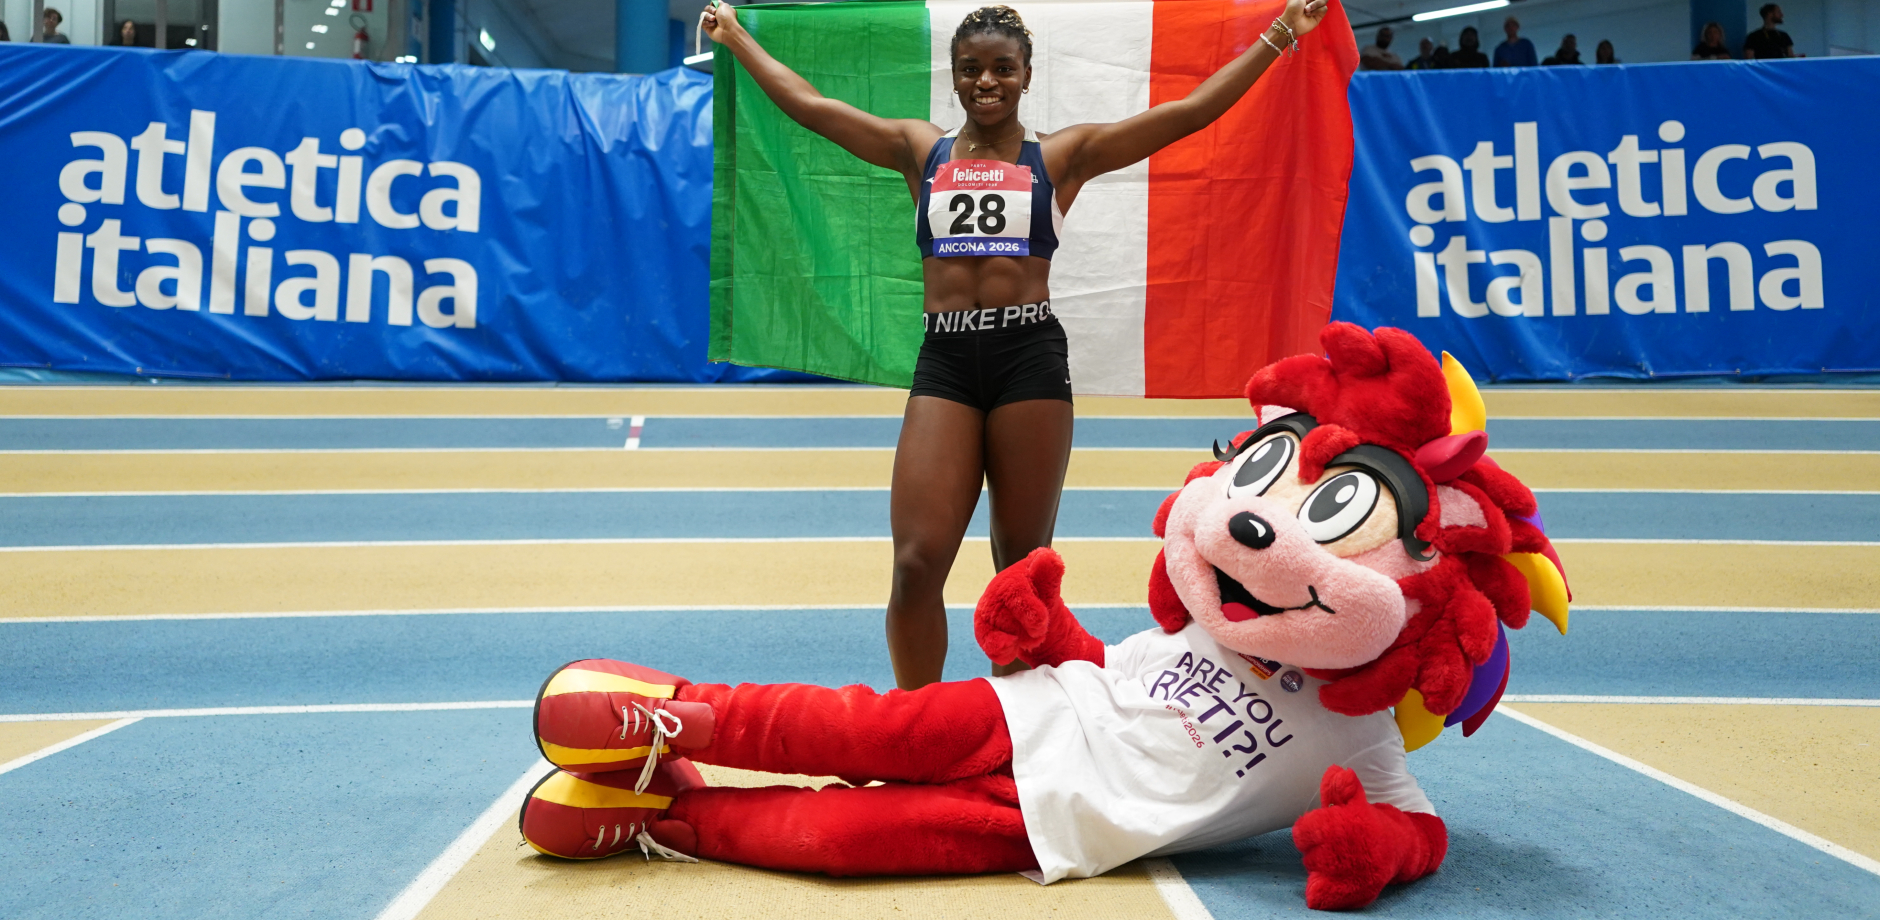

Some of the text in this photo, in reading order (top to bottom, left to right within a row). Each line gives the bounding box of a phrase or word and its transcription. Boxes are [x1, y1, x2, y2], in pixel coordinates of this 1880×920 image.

[59, 109, 482, 233] atletica
[948, 193, 1006, 235] 28
[952, 168, 1004, 183] felicetti
[1405, 120, 1818, 224] atletica
[53, 203, 479, 329] italiana
[938, 242, 1020, 253] ANCONA 2026
[1409, 216, 1824, 319] italiana
[934, 308, 997, 333] NIKE
[1002, 300, 1050, 328] PRO
[1149, 670, 1267, 778] RIETI?!
[1175, 651, 1293, 748] ARE YOU
